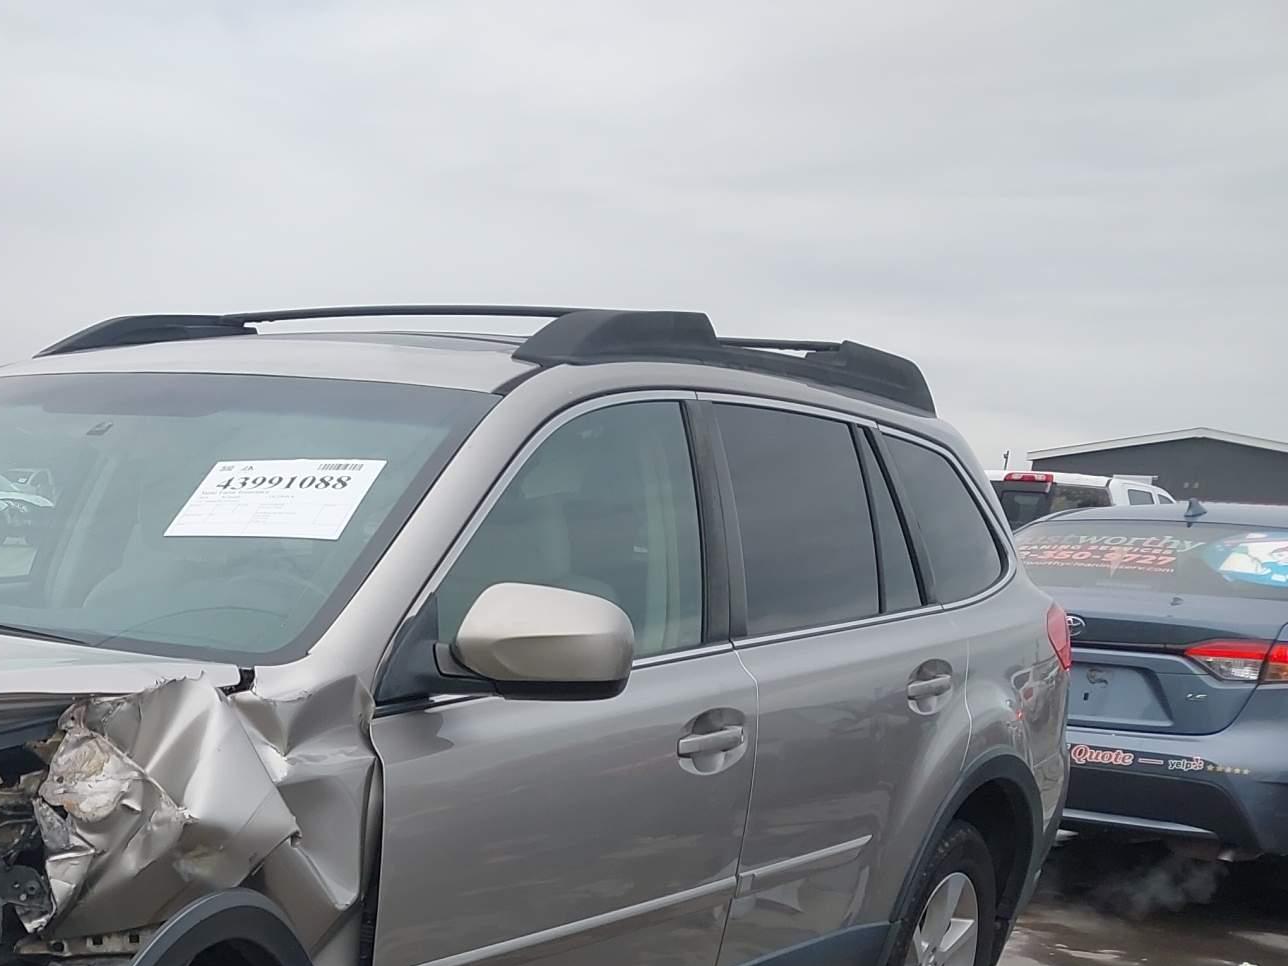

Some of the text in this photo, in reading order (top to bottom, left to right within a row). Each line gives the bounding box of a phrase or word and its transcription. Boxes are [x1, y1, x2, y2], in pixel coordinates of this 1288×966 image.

[216, 475, 352, 490] 43991088
[1071, 744, 1134, 766] Quote
[1168, 758, 1194, 771] yelp
